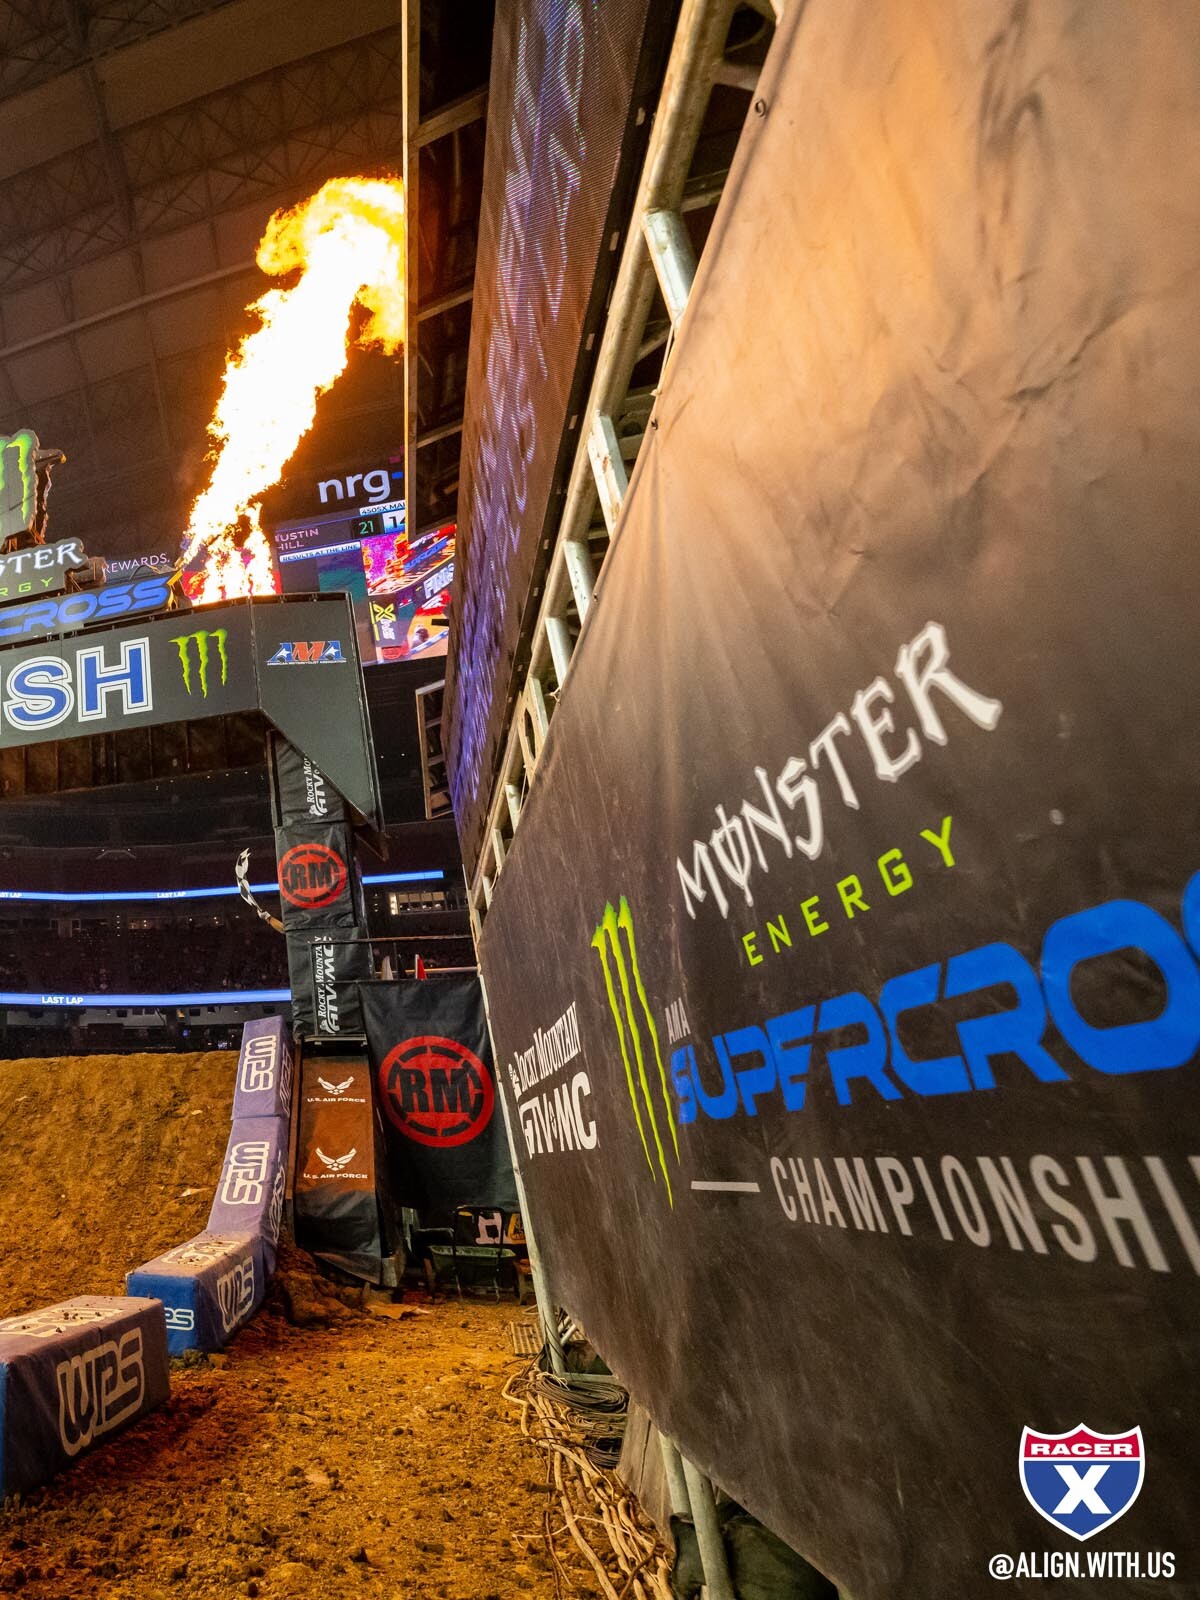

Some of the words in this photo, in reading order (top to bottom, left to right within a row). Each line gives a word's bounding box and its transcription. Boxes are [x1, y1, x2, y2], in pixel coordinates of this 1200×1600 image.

[318, 469, 391, 503] nrg
[359, 520, 375, 535] 21
[267, 640, 347, 662] AMA
[741, 815, 956, 967] ENERGY
[41, 996, 64, 1004] LAST
[65, 996, 84, 1005] LAP
[318, 986, 327, 1018] ROCKY
[664, 996, 692, 1046] AMA
[670, 869, 1200, 1126] SUPERCRO
[240, 1034, 278, 1093] WPS
[513, 1044, 541, 1093] ROCKY
[532, 999, 583, 1081] MOUNTAIN
[400, 1067, 473, 1114] RM
[221, 1141, 270, 1205] WPS
[303, 1172, 319, 1180] U.S.
[769, 1154, 1200, 1278] CHAMPIONSHI
[164, 1306, 195, 1331] PS
[216, 1256, 255, 1334] WPS
[56, 1326, 146, 1456] WPS
